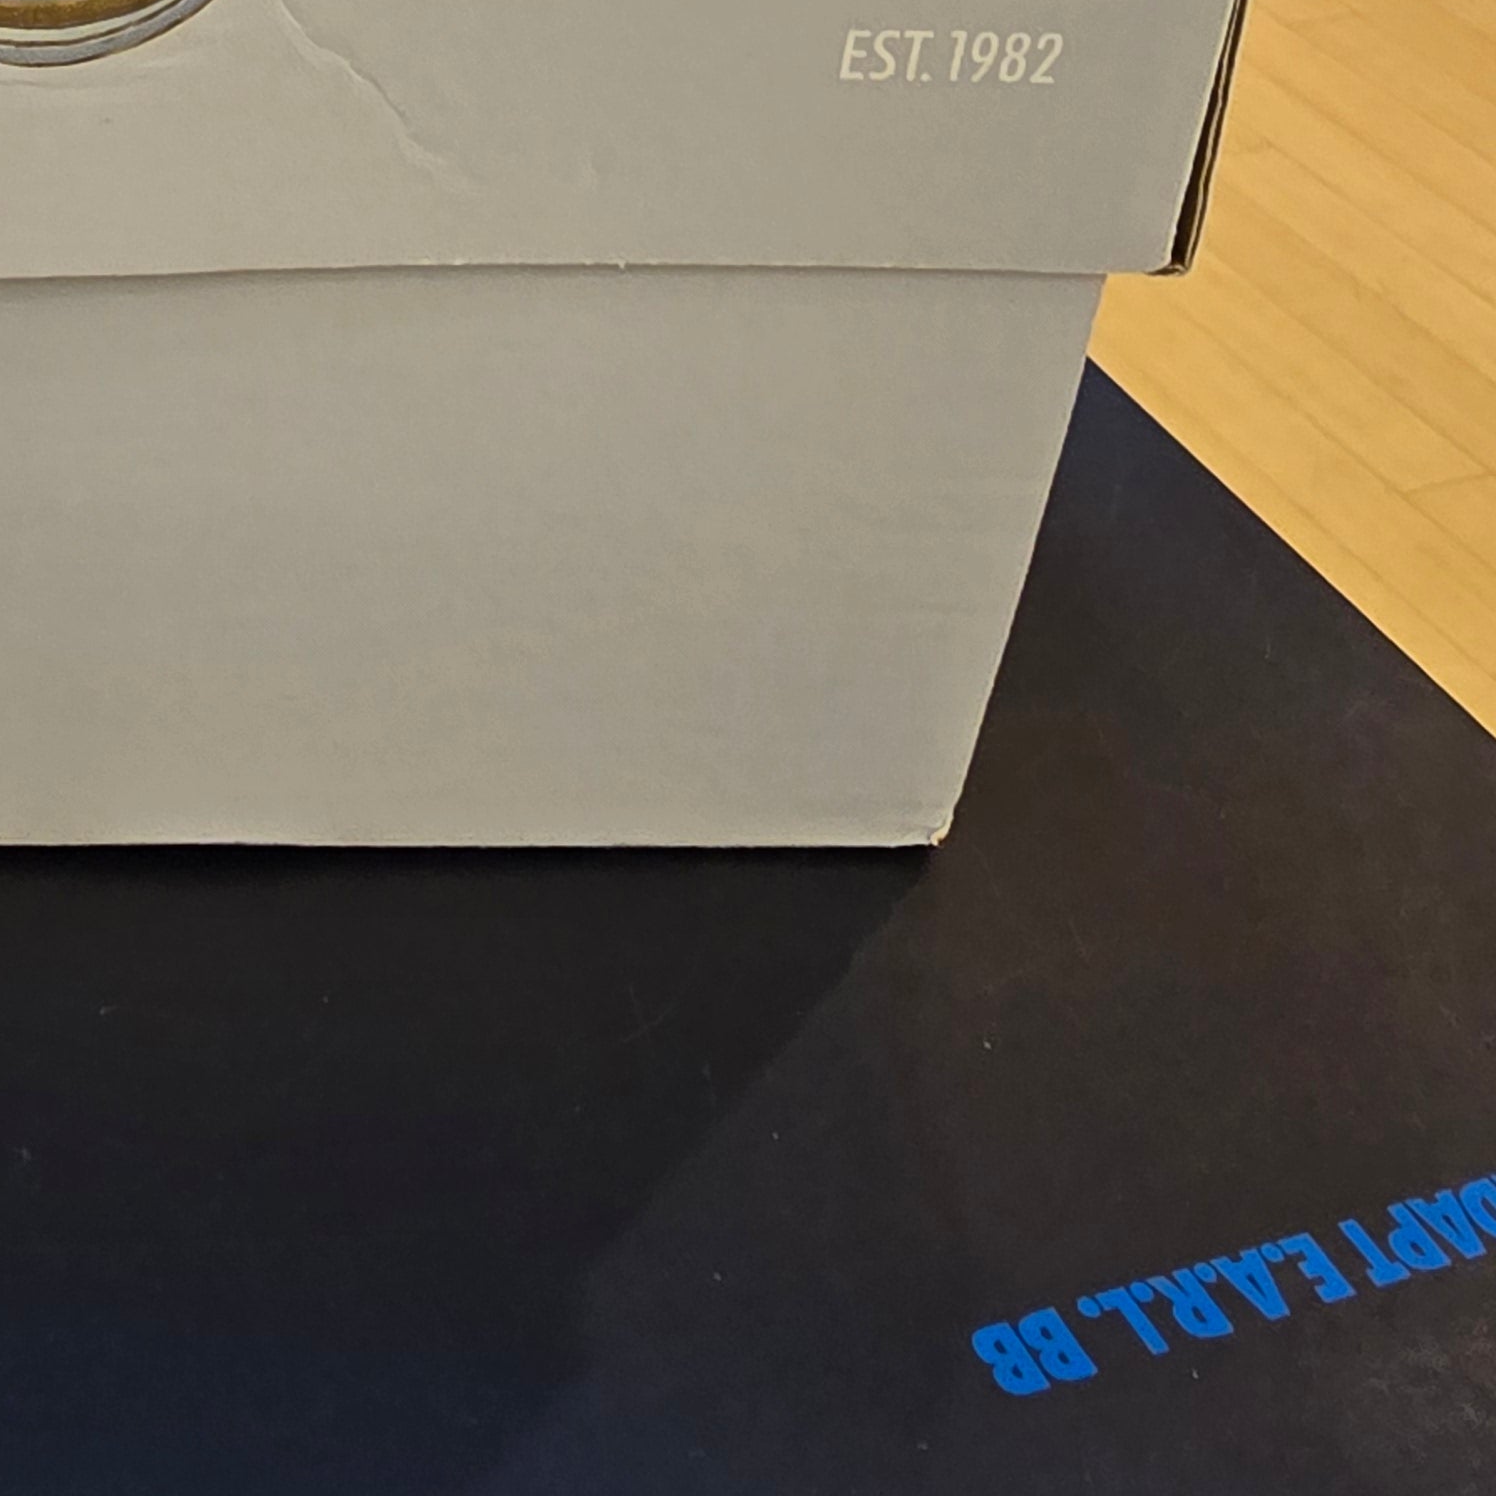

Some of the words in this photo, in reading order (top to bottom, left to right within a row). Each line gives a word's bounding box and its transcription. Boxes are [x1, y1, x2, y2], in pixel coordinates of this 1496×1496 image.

[839, 29, 933, 82] EST.
[949, 30, 1064, 84] 1982
[1338, 1175, 1496, 1287] DAPT
[1076, 1233, 1356, 1355] E.A.R.L.
[971, 1308, 1098, 1396] BB
